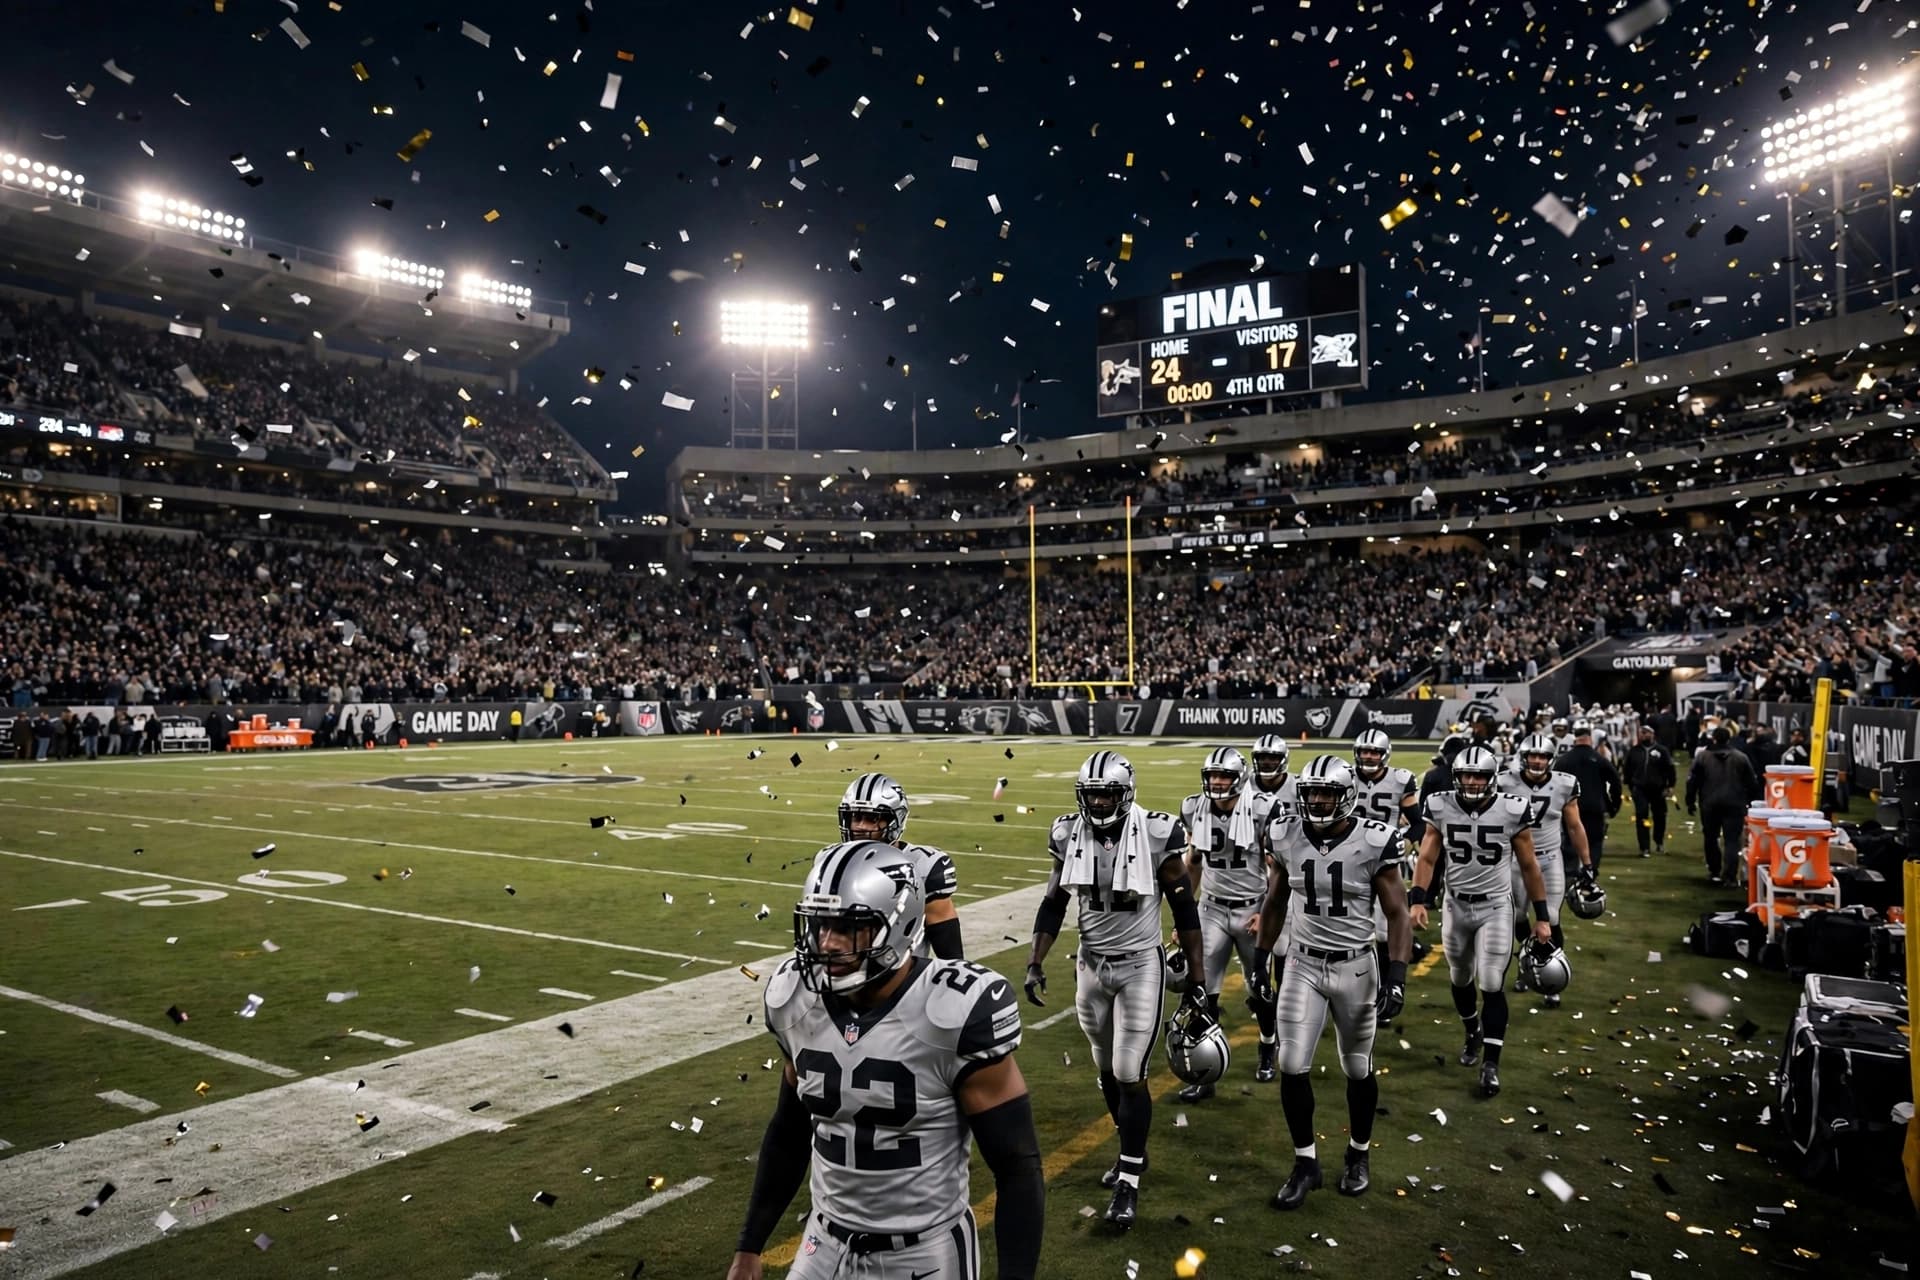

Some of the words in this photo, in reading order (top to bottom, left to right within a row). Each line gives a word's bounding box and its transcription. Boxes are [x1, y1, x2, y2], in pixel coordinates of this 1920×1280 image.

[1162, 281, 1283, 334] FINAL
[1236, 323, 1299, 346] VISITORS
[1150, 338, 1190, 358] HOME
[1265, 341, 1297, 370] 17
[1150, 357, 1181, 385] 24
[1167, 381, 1213, 404] 00:00
[1226, 377, 1254, 396] 4TH
[1256, 373, 1285, 393] QTR
[1612, 655, 1677, 669] GATORADE
[412, 711, 464, 734] GAME
[473, 710, 500, 732] DAY
[1178, 708, 1219, 725] THANK
[1222, 708, 1249, 724] YOU
[1252, 707, 1286, 724] FANS
[1852, 723, 1881, 770] GAME
[1883, 727, 1906, 763] DAY
[1770, 781, 1785, 798] G
[1446, 823, 1504, 865] 55
[1783, 839, 1807, 864] G
[1301, 859, 1348, 917] 11
[795, 1047, 922, 1171] 22
